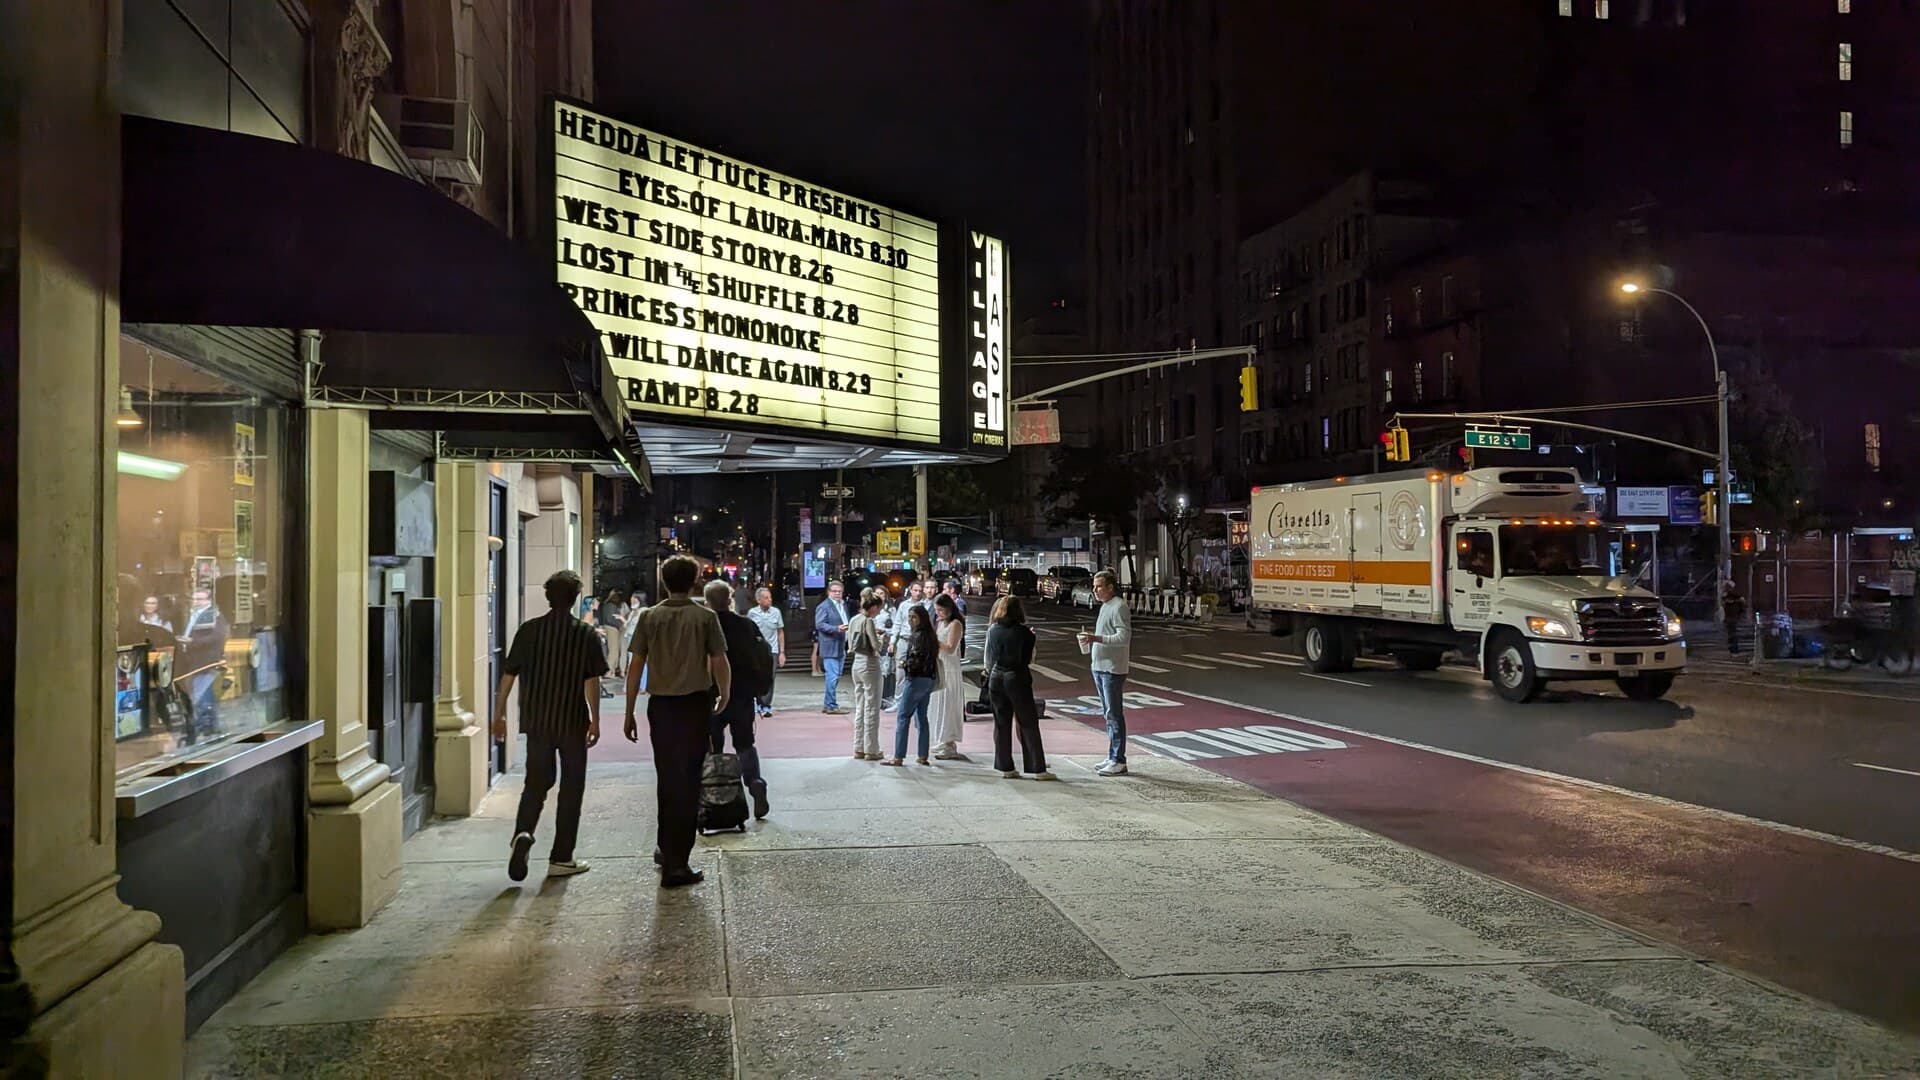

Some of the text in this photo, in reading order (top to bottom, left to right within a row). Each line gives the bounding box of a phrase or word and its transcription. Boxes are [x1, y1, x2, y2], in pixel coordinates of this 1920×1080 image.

[560, 108, 880, 229] HEDDA LETTUCE PRESENTS
[563, 195, 640, 238] WEST
[649, 219, 703, 255] SIDE
[870, 241, 908, 270] 8.30
[563, 238, 859, 325] LOST IN THE SHUFFLE 8.28
[703, 309, 821, 353] MONONOKE
[971, 230, 986, 430] VILLAGE
[609, 331, 871, 395] WILL DANCE AGAIN 8.29
[705, 387, 759, 415] 8.28
[1478, 434, 1486, 444] E
[1488, 435, 1500, 445] 12
[1268, 502, 1330, 538] Citarella
[1260, 564, 1336, 577] FINE FOOD AT ITS BEST
[1127, 725, 1348, 760] ONLY
